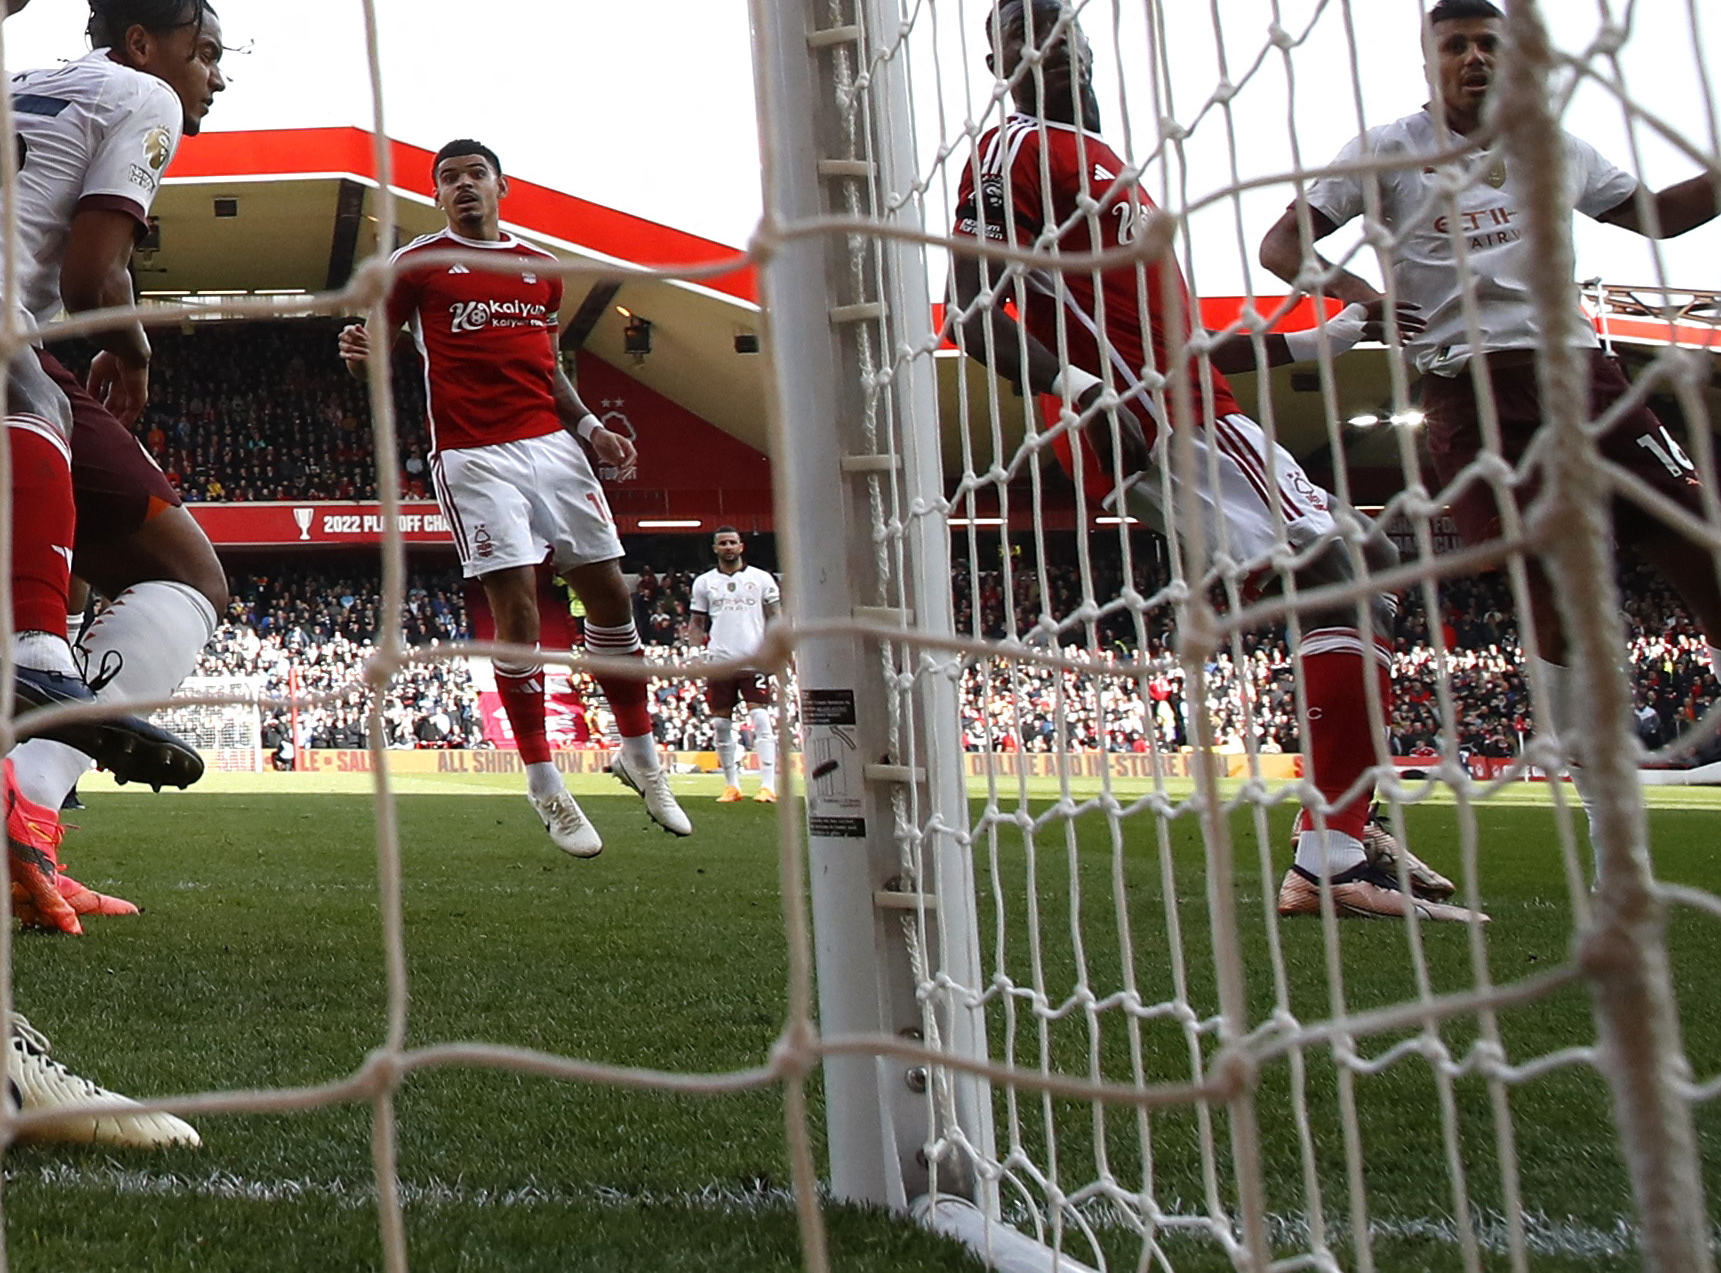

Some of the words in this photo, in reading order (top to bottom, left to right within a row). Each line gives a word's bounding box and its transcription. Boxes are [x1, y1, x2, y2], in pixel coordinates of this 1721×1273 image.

[323, 515, 361, 532] 2022
[363, 514, 421, 532] PLOFF
[438, 750, 469, 773] ALL
[472, 751, 524, 773] SHIRT
